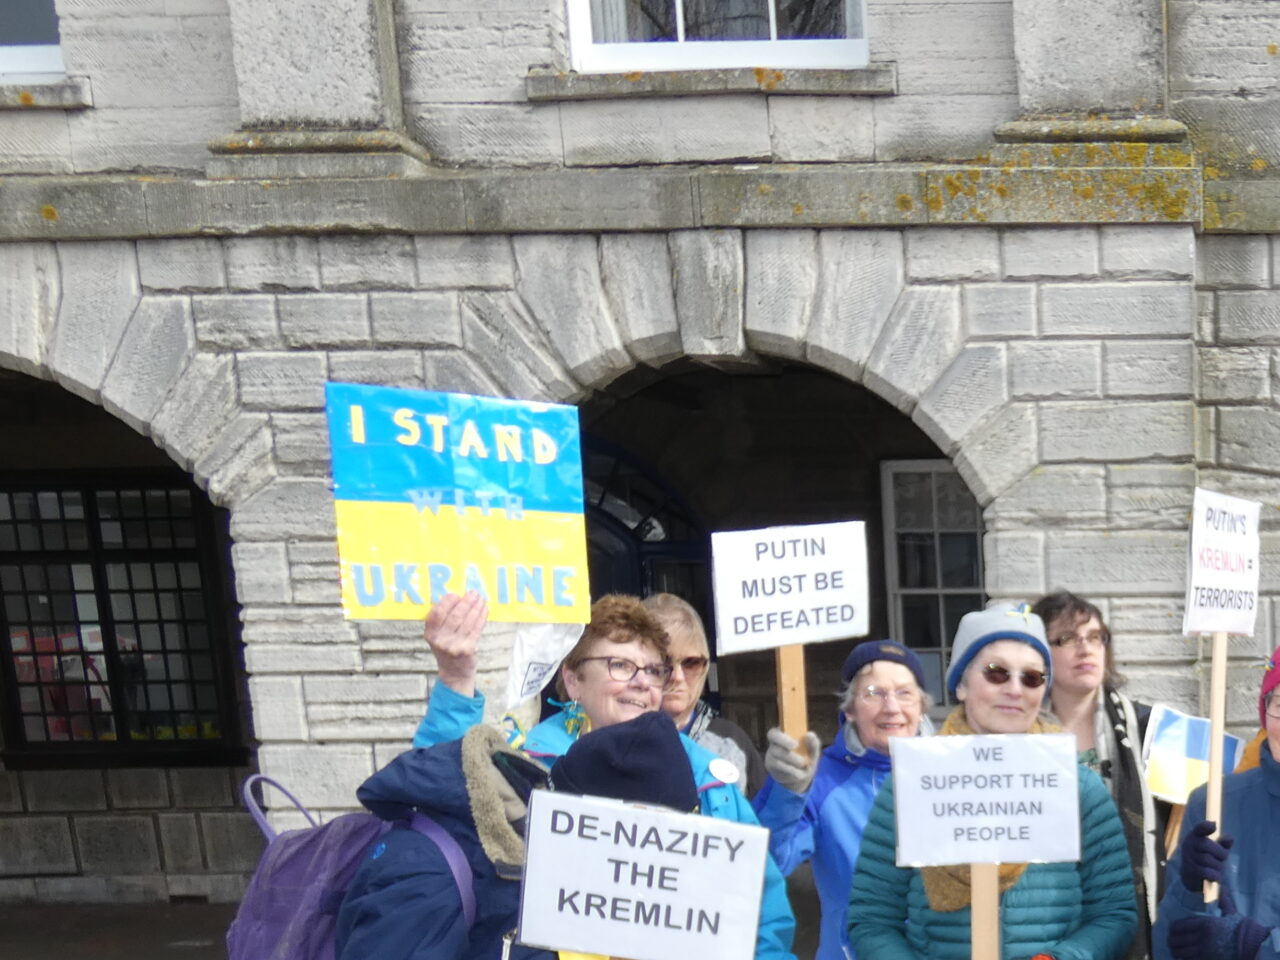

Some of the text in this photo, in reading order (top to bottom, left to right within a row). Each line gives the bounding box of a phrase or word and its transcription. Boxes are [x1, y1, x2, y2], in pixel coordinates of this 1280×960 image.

[350, 405, 558, 464] I STAND
[407, 487, 523, 520] WITH
[1205, 507, 1247, 535] PUTIN'S
[755, 536, 826, 561] PUTIN
[1199, 547, 1245, 573] KREMLIN
[351, 563, 576, 607] UKRAINE
[742, 570, 844, 599] MUST BE
[1193, 586, 1254, 611] TERRORISTS
[733, 604, 855, 635] DEFEATED
[973, 747, 1004, 762] WE
[920, 773, 1059, 790] SUPPORT THE
[932, 801, 1043, 817] UKRAINIAN
[551, 809, 745, 862] DE-NAZIFY
[953, 825, 1031, 842] PEOPLE
[607, 858, 680, 892] THE
[557, 888, 721, 935] KREMLIN
